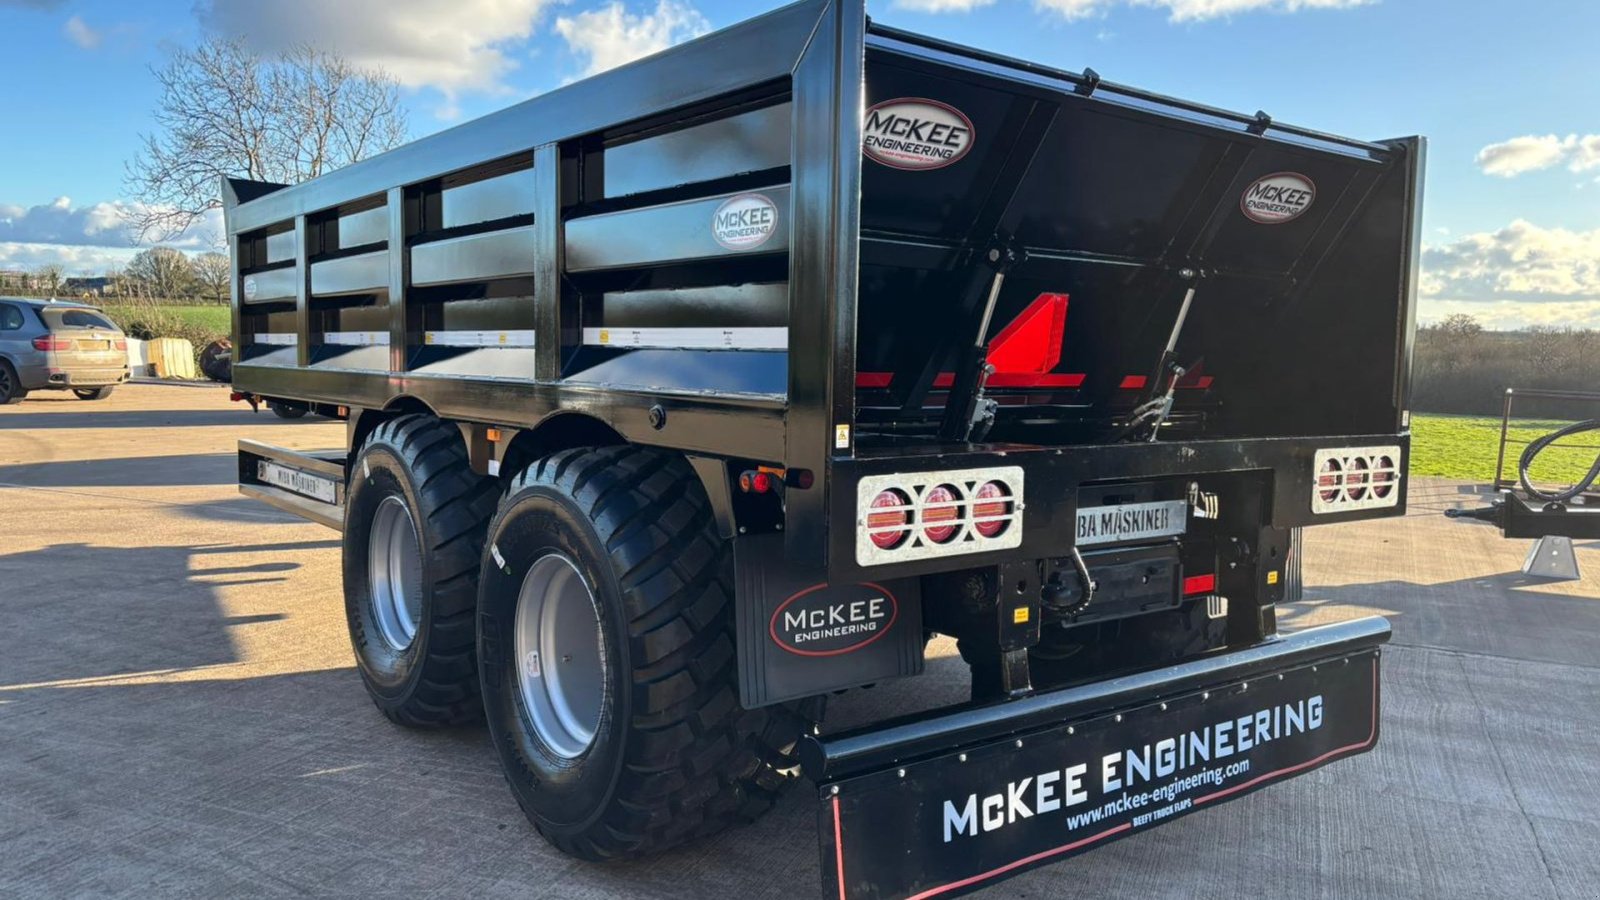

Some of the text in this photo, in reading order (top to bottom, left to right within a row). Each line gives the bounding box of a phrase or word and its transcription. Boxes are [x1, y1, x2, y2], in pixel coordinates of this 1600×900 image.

[864, 135, 954, 159] ENGINEERING
[1246, 200, 1299, 215] ENGINEERING
[720, 225, 769, 239] ENGINEERING
[794, 622, 877, 643] ENGINEERING
[1102, 695, 1323, 792] ENGINEERING
[1066, 759, 1250, 831] www.mckee-engineering.com
[1132, 798, 1192, 827] BEEFY TRUCK FLAPS
